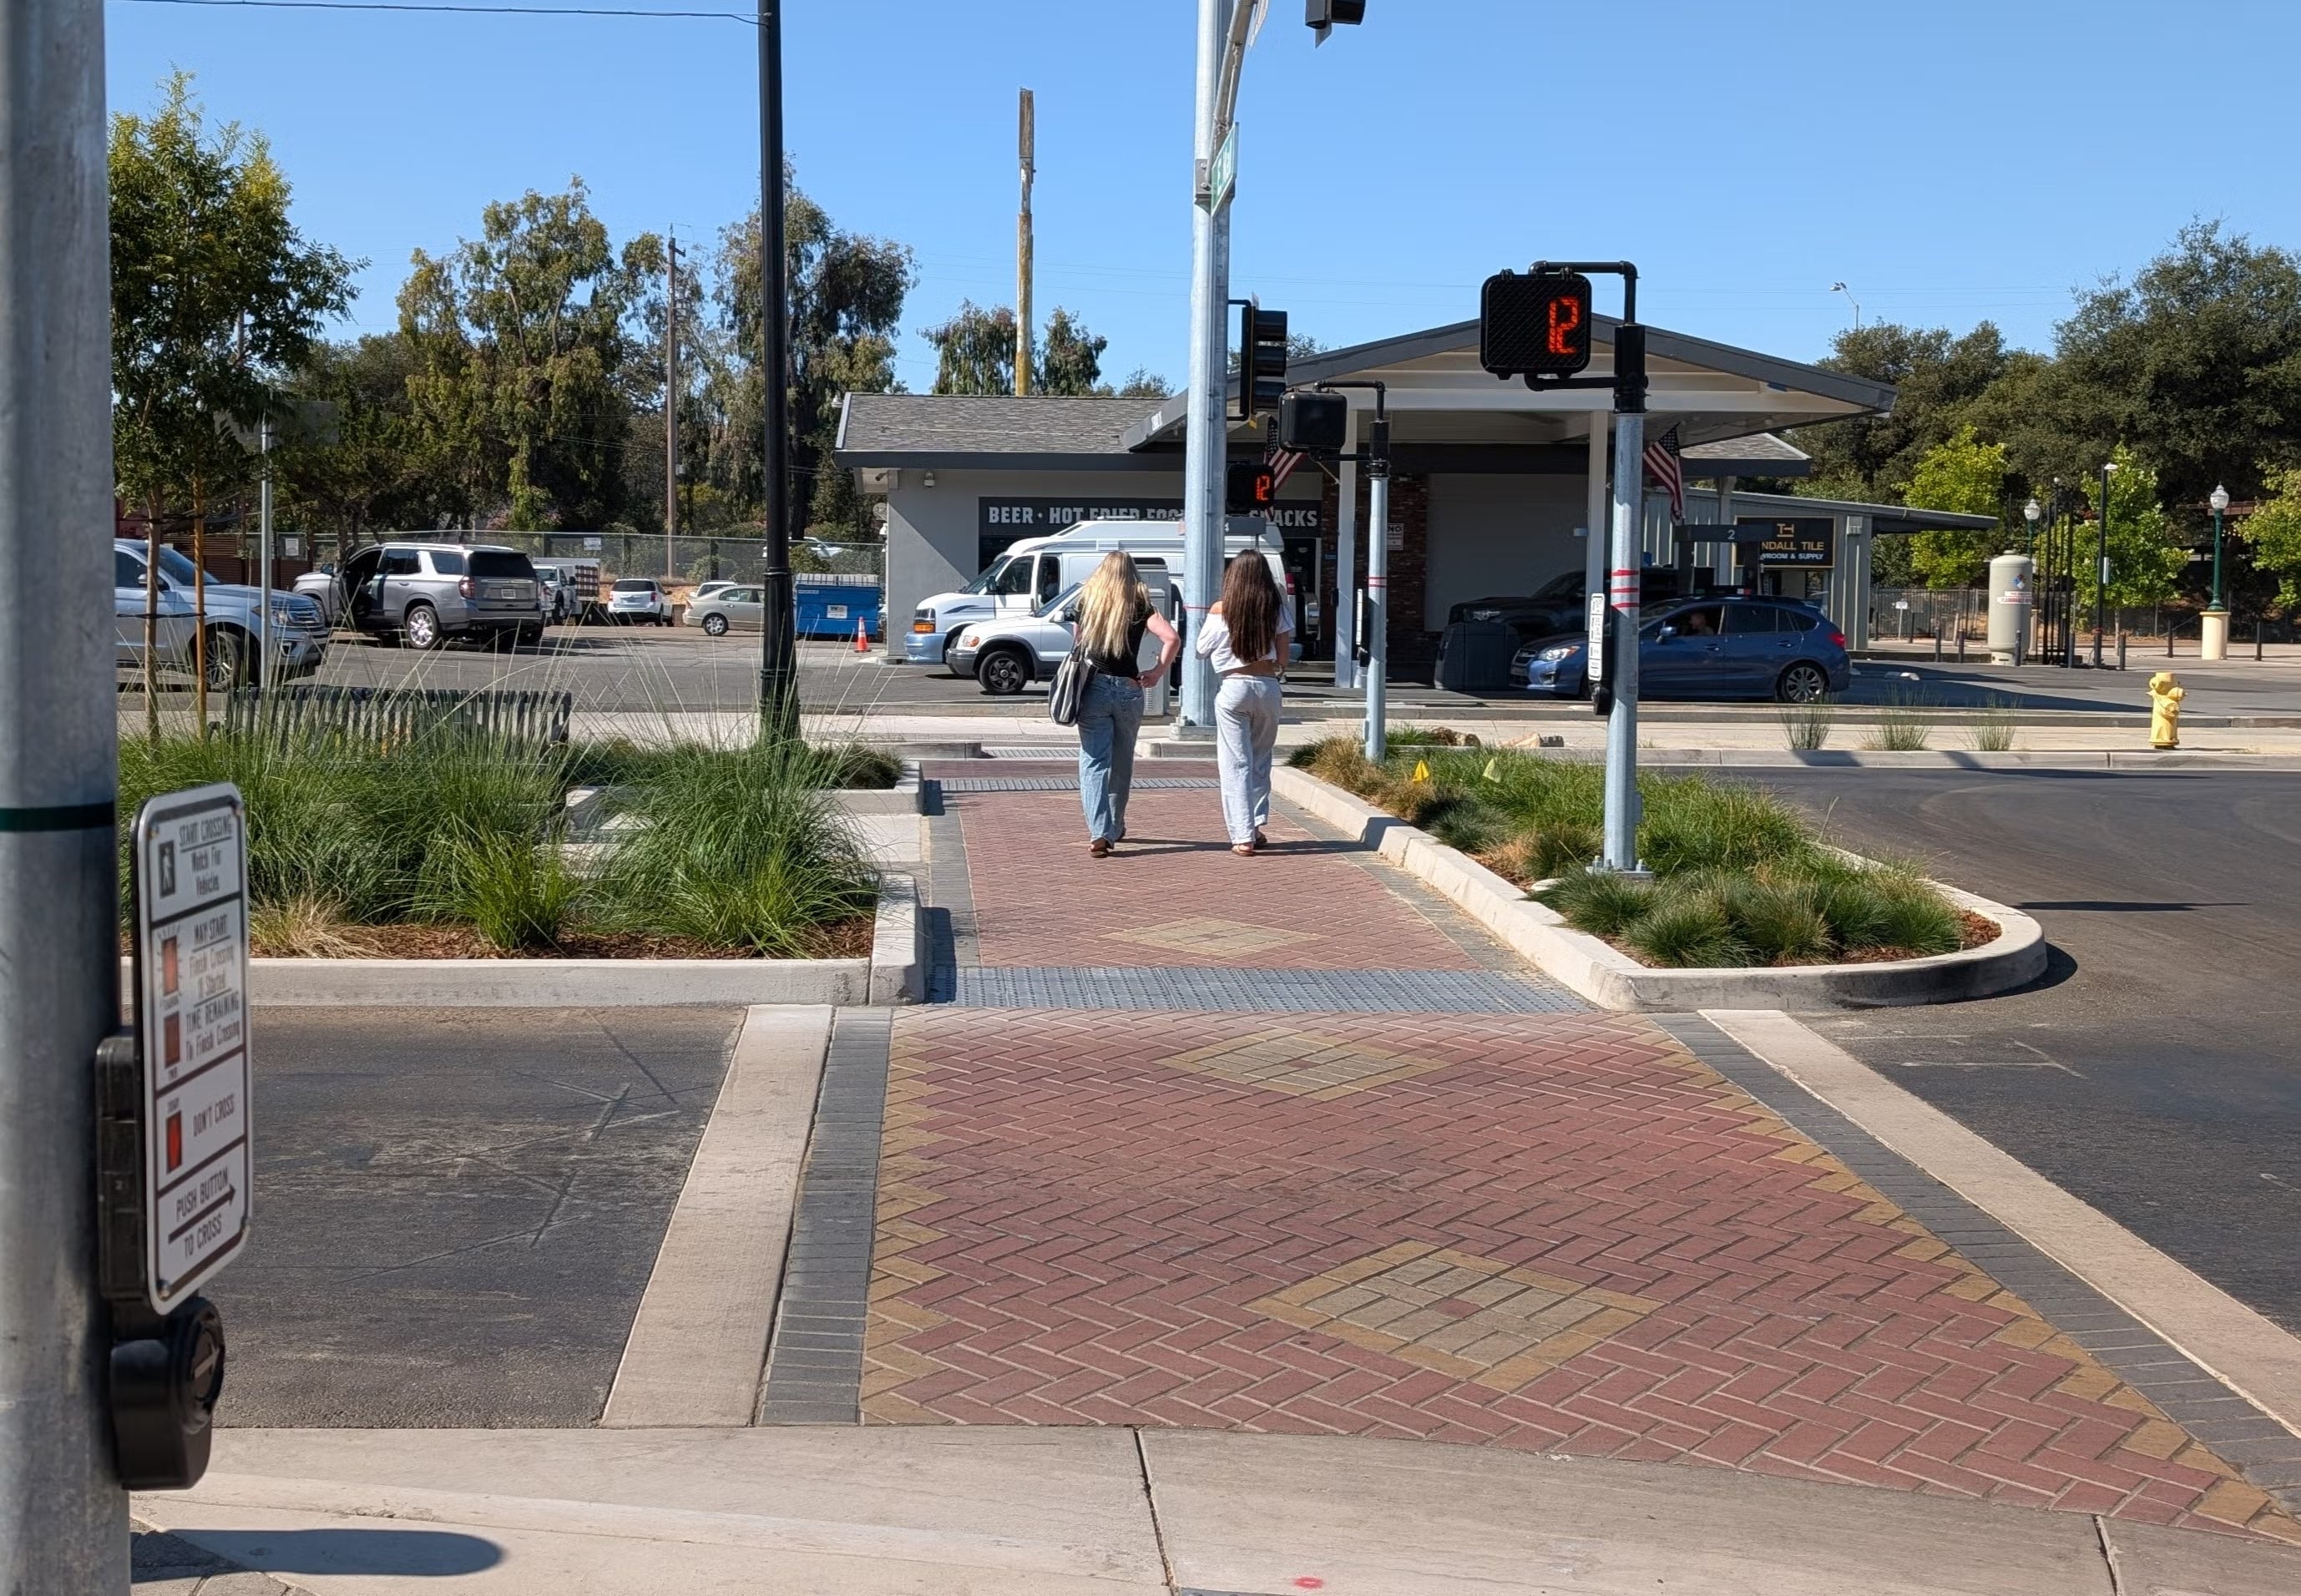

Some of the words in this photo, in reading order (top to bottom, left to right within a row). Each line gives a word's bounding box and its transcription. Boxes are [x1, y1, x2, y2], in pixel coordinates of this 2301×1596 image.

[1549, 296, 1579, 354] 12
[1256, 474, 1271, 501] 12
[989, 506, 1034, 524] BEER
[1049, 507, 1084, 524] HOT
[1727, 529, 1736, 540] 2
[1801, 541, 1824, 551] TILE
[179, 823, 199, 846] START
[200, 814, 233, 841] CROSSING
[186, 1008, 201, 1033] TIME
[205, 991, 240, 1024] REMAINING
[194, 1107, 212, 1136] DON'T
[215, 1093, 235, 1124] CROSS
[176, 1188, 197, 1222] PUSH
[200, 1166, 228, 1204] BUTTON
[185, 1234, 194, 1260] TO
[197, 1213, 222, 1249] CROSS
